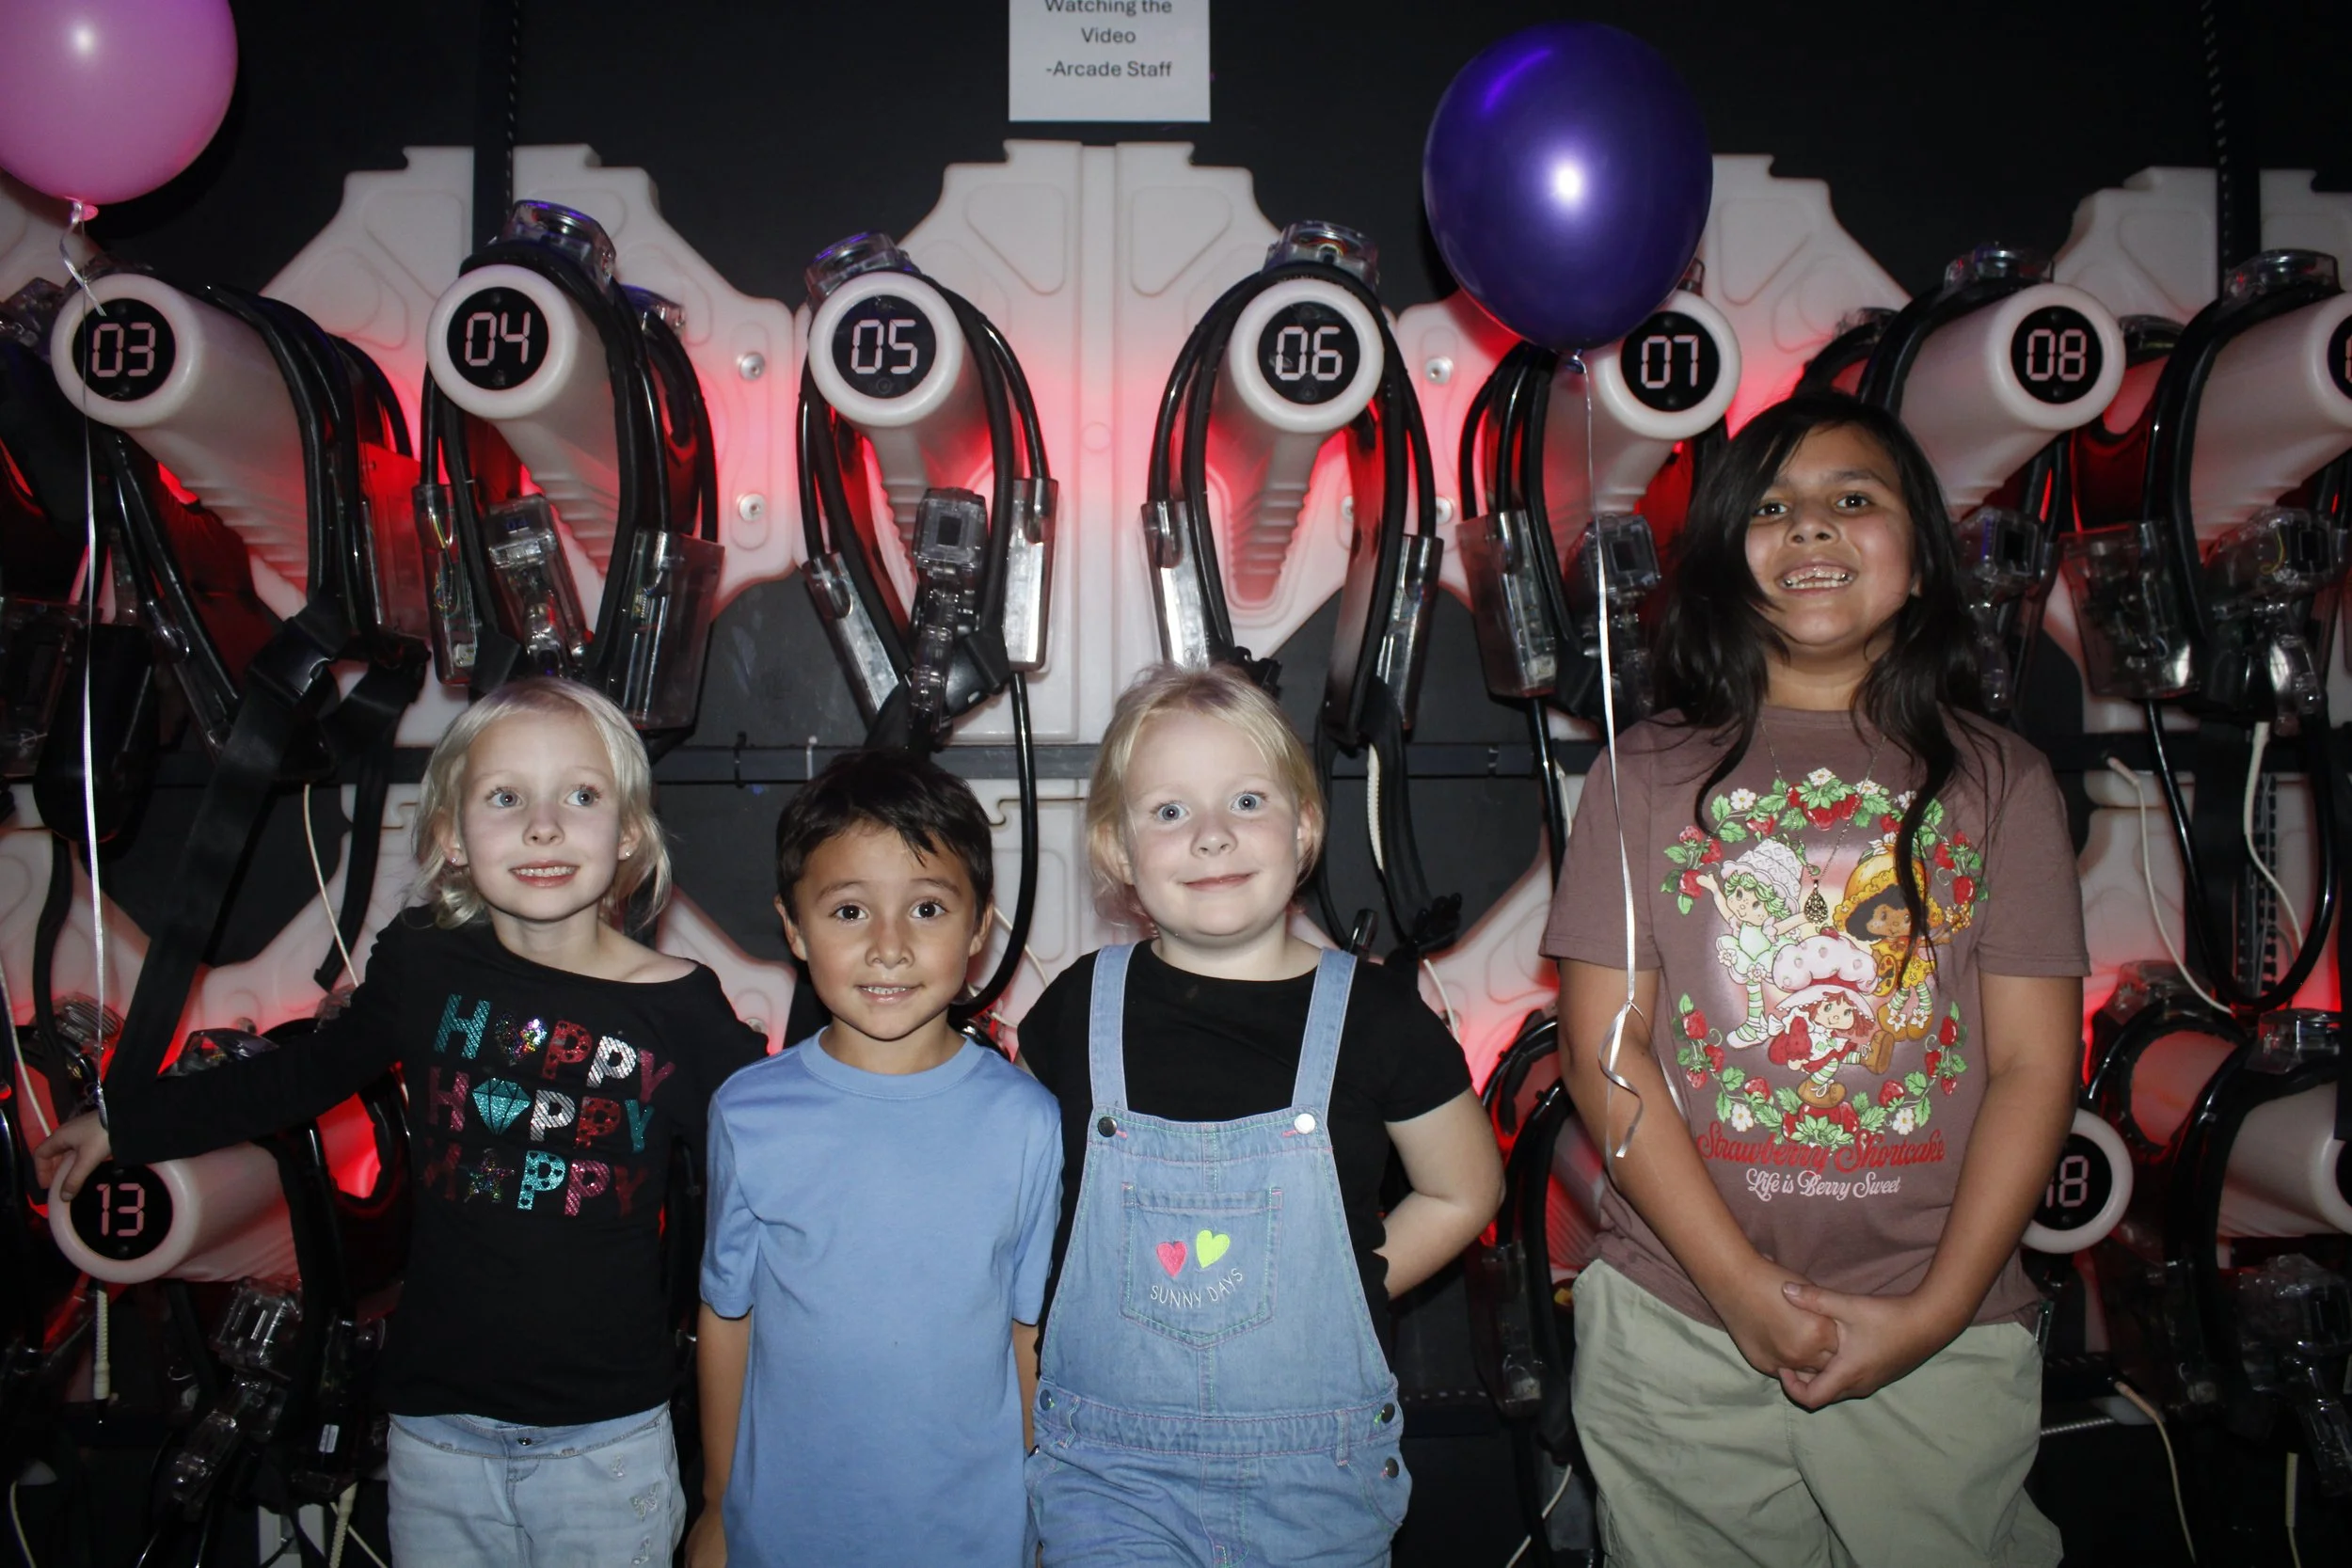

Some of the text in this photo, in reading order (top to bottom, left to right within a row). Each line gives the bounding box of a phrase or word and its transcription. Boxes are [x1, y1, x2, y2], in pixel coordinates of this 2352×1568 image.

[1046, 0, 1173, 17] Watching the
[1080, 26, 1136, 44] Video
[1045, 60, 1173, 78] -Arcade Staff
[91, 322, 156, 378] 03
[465, 309, 531, 368] 04
[850, 318, 919, 375] 05
[1275, 325, 1344, 383] 06
[1640, 333, 1700, 389] 07
[2026, 326, 2088, 383] 08
[433, 993, 675, 1103] HPPY
[426, 1065, 655, 1154] HPPY
[1696, 1120, 1947, 1174] Strawberry Shortcake
[96, 1181, 146, 1238] 13
[1745, 1167, 1901, 1202] Life is Berry Sweet
[1150, 1267, 1244, 1309] SUNNY DAYS
